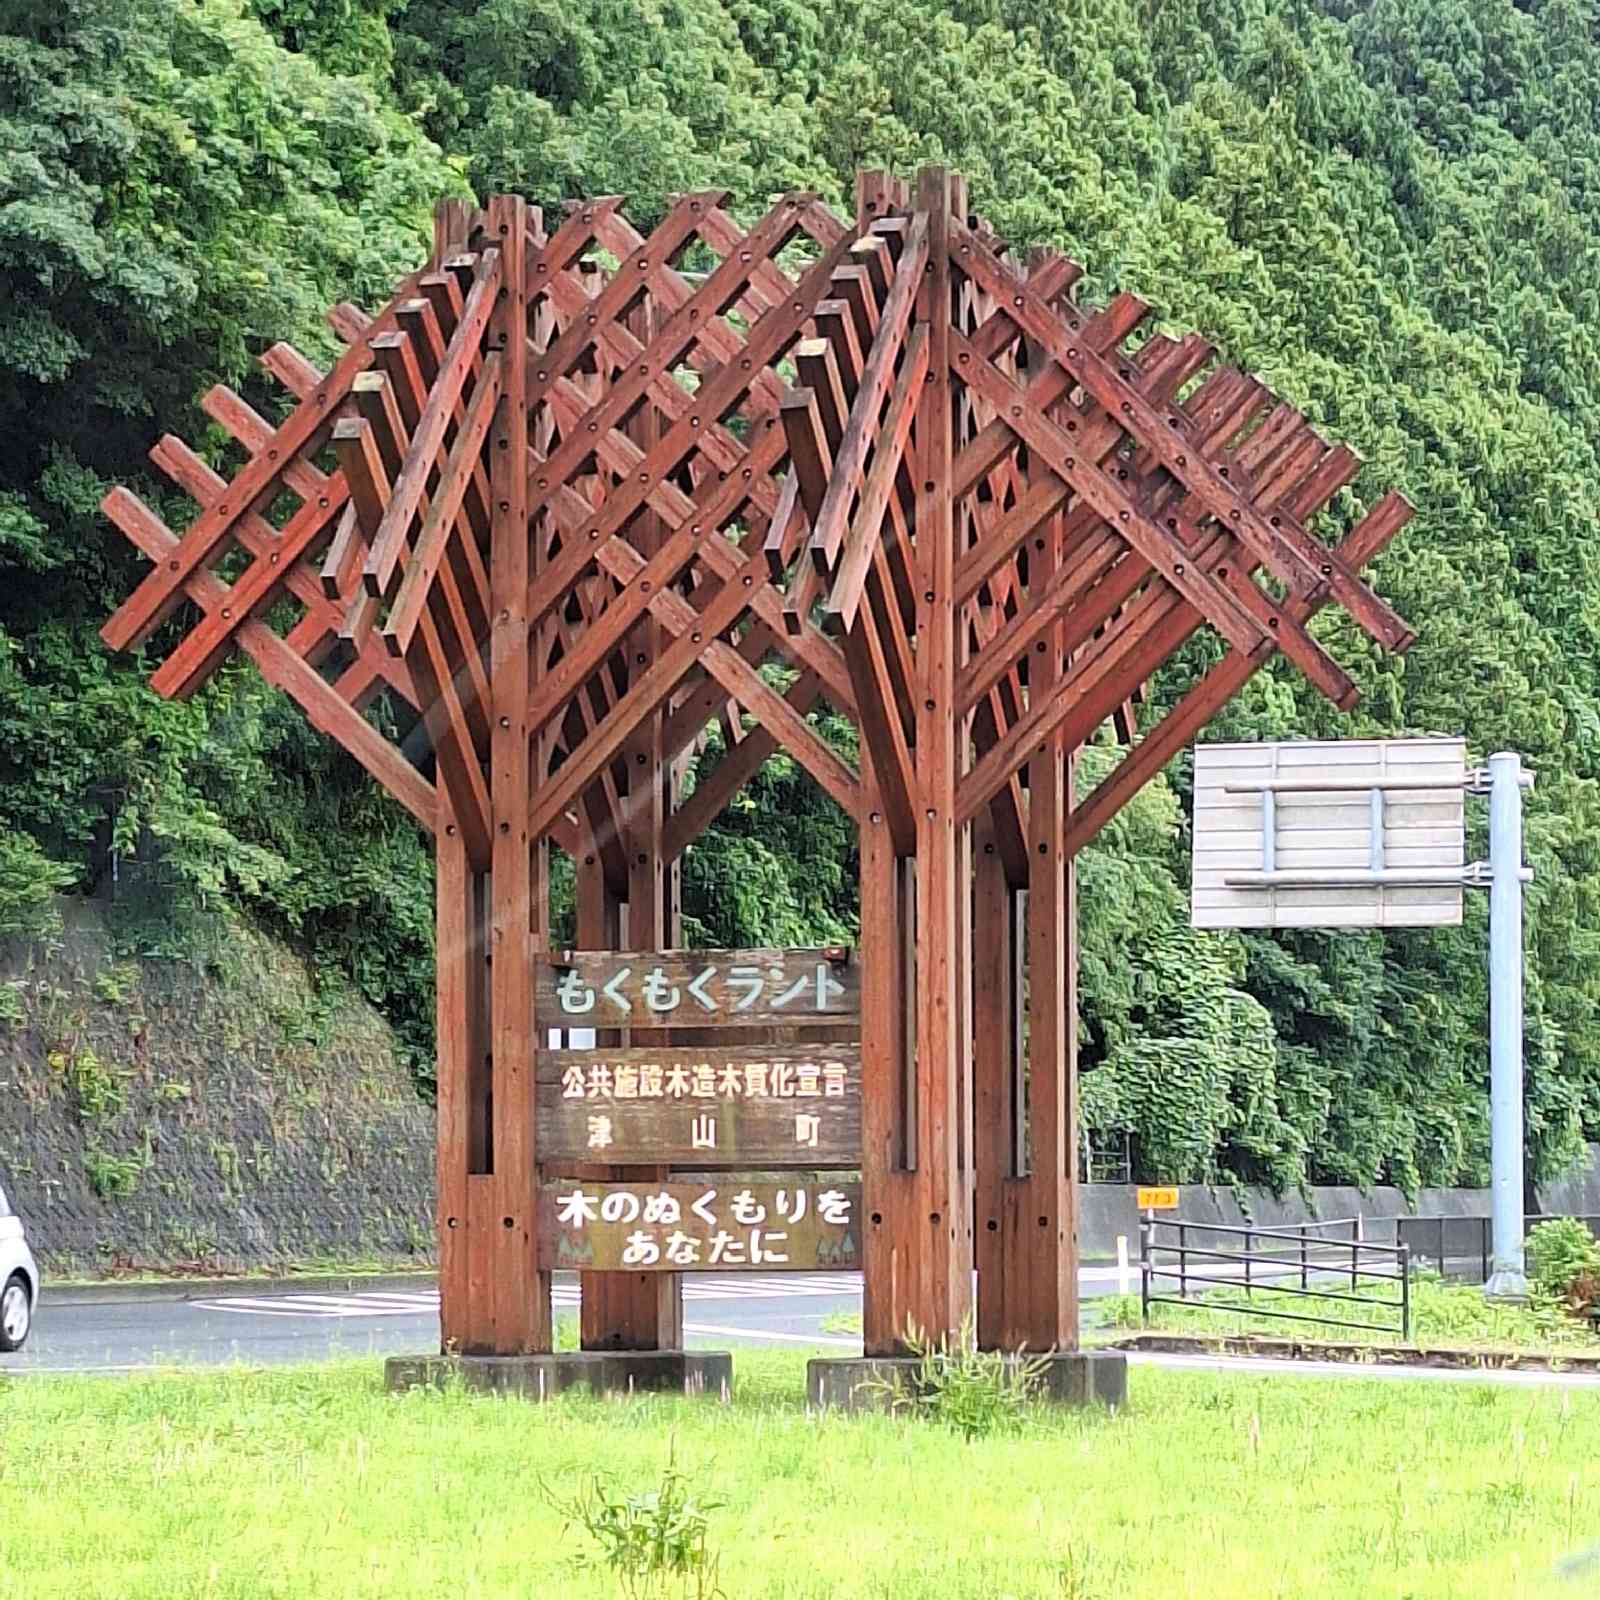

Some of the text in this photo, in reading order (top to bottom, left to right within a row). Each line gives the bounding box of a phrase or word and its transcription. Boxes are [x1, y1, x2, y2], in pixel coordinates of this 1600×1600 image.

[561, 1063, 848, 1098] 公共施設木造木質化宣言
[556, 1190, 851, 1228] 木のぬくもりを
[623, 1229, 789, 1264] あなたに
